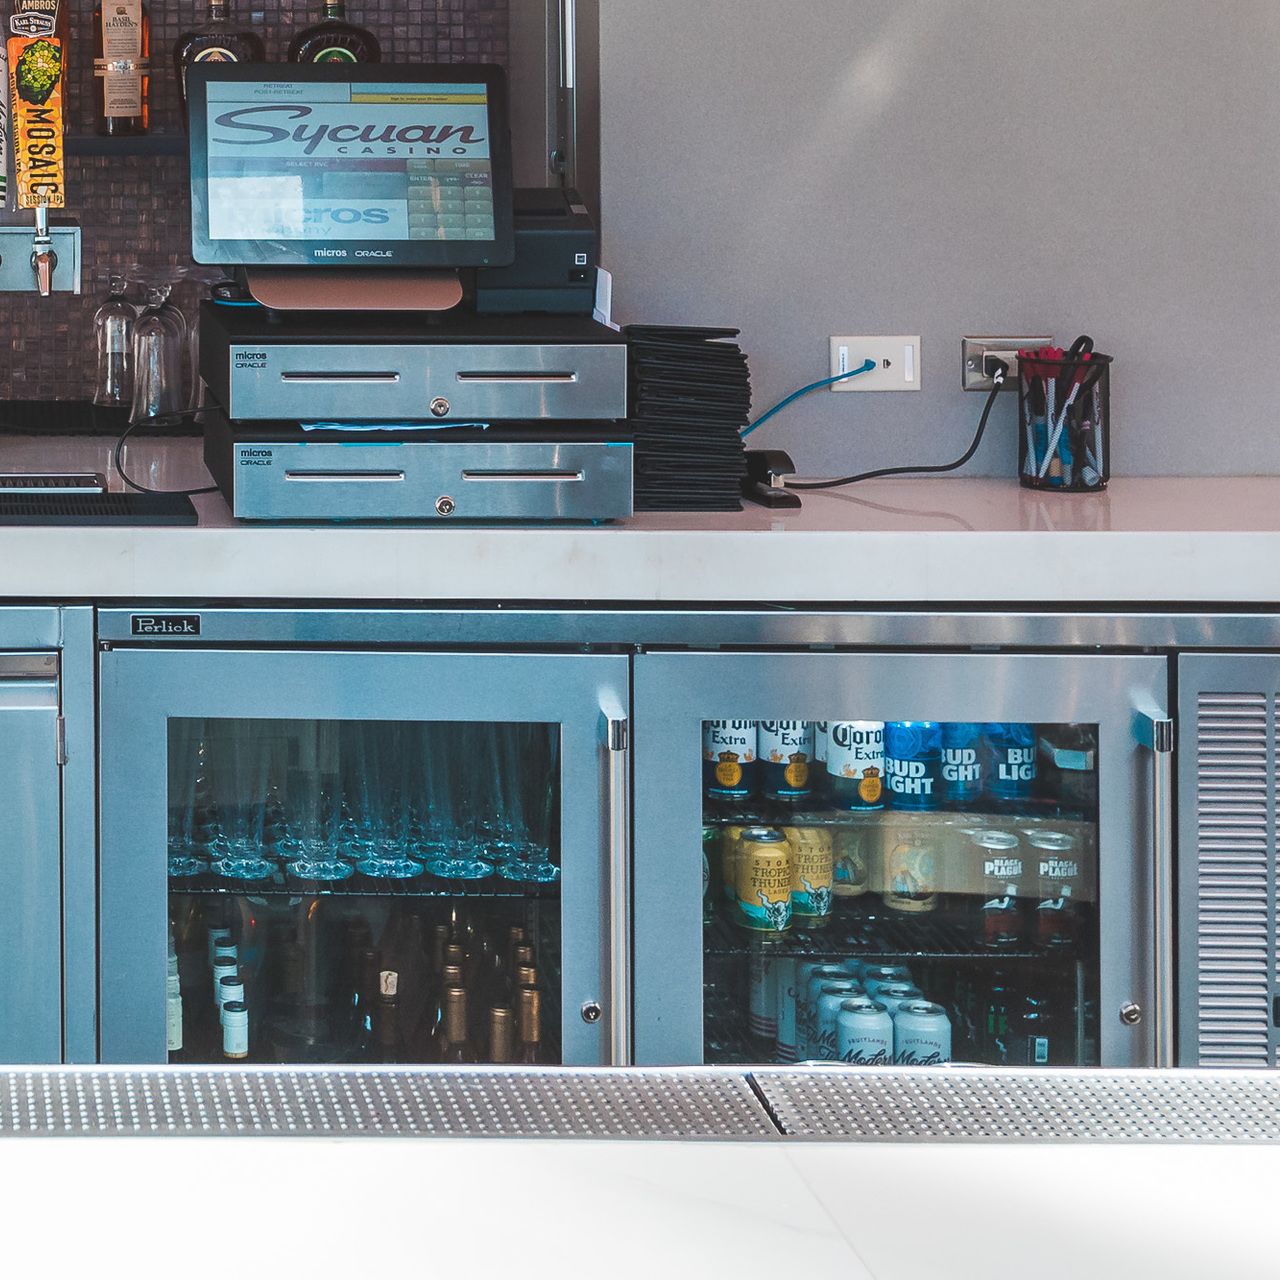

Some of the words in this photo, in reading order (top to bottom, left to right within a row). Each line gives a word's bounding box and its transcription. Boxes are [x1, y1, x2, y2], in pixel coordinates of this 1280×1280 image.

[21, 0, 56, 10] AMBROS
[212, 105, 486, 156] Sycuan
[26, 108, 59, 194] MOSAIC
[336, 146, 468, 155] CASINO
[314, 248, 347, 257] micros
[235, 351, 267, 360] micros
[240, 448, 273, 457] micros
[136, 617, 196, 633] Perlick
[711, 730, 747, 745] Extra
